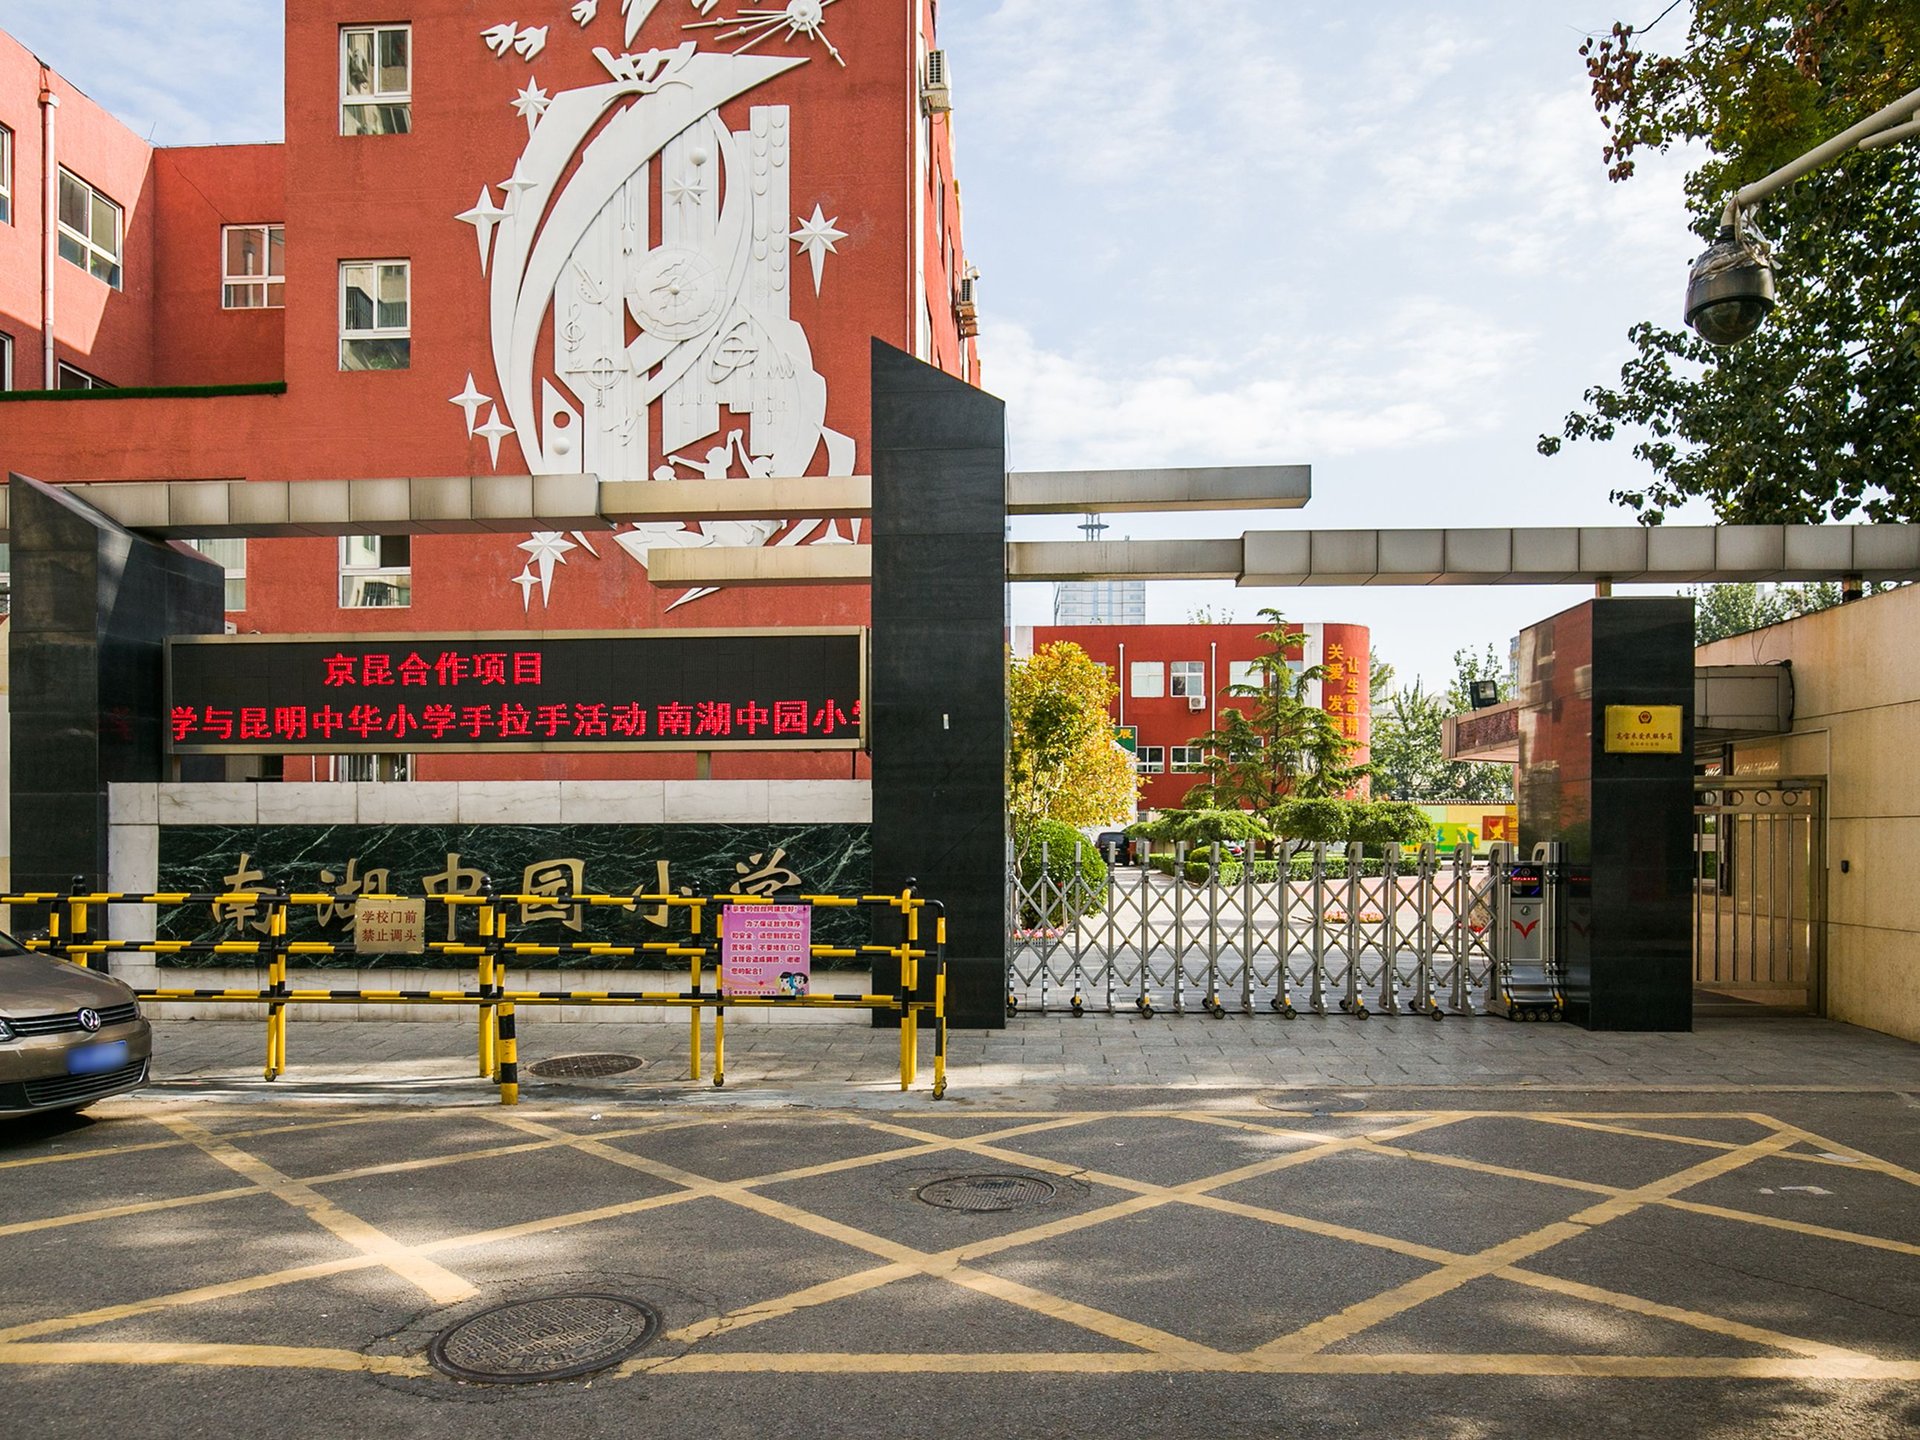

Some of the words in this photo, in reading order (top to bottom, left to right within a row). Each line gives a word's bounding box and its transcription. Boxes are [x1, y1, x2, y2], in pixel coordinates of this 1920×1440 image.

[323, 651, 542, 687] 京昆合作项目
[657, 699, 861, 737] 南湖中园小
[362, 910, 418, 924] 学校门前
[362, 928, 417, 942] 禁止调头
